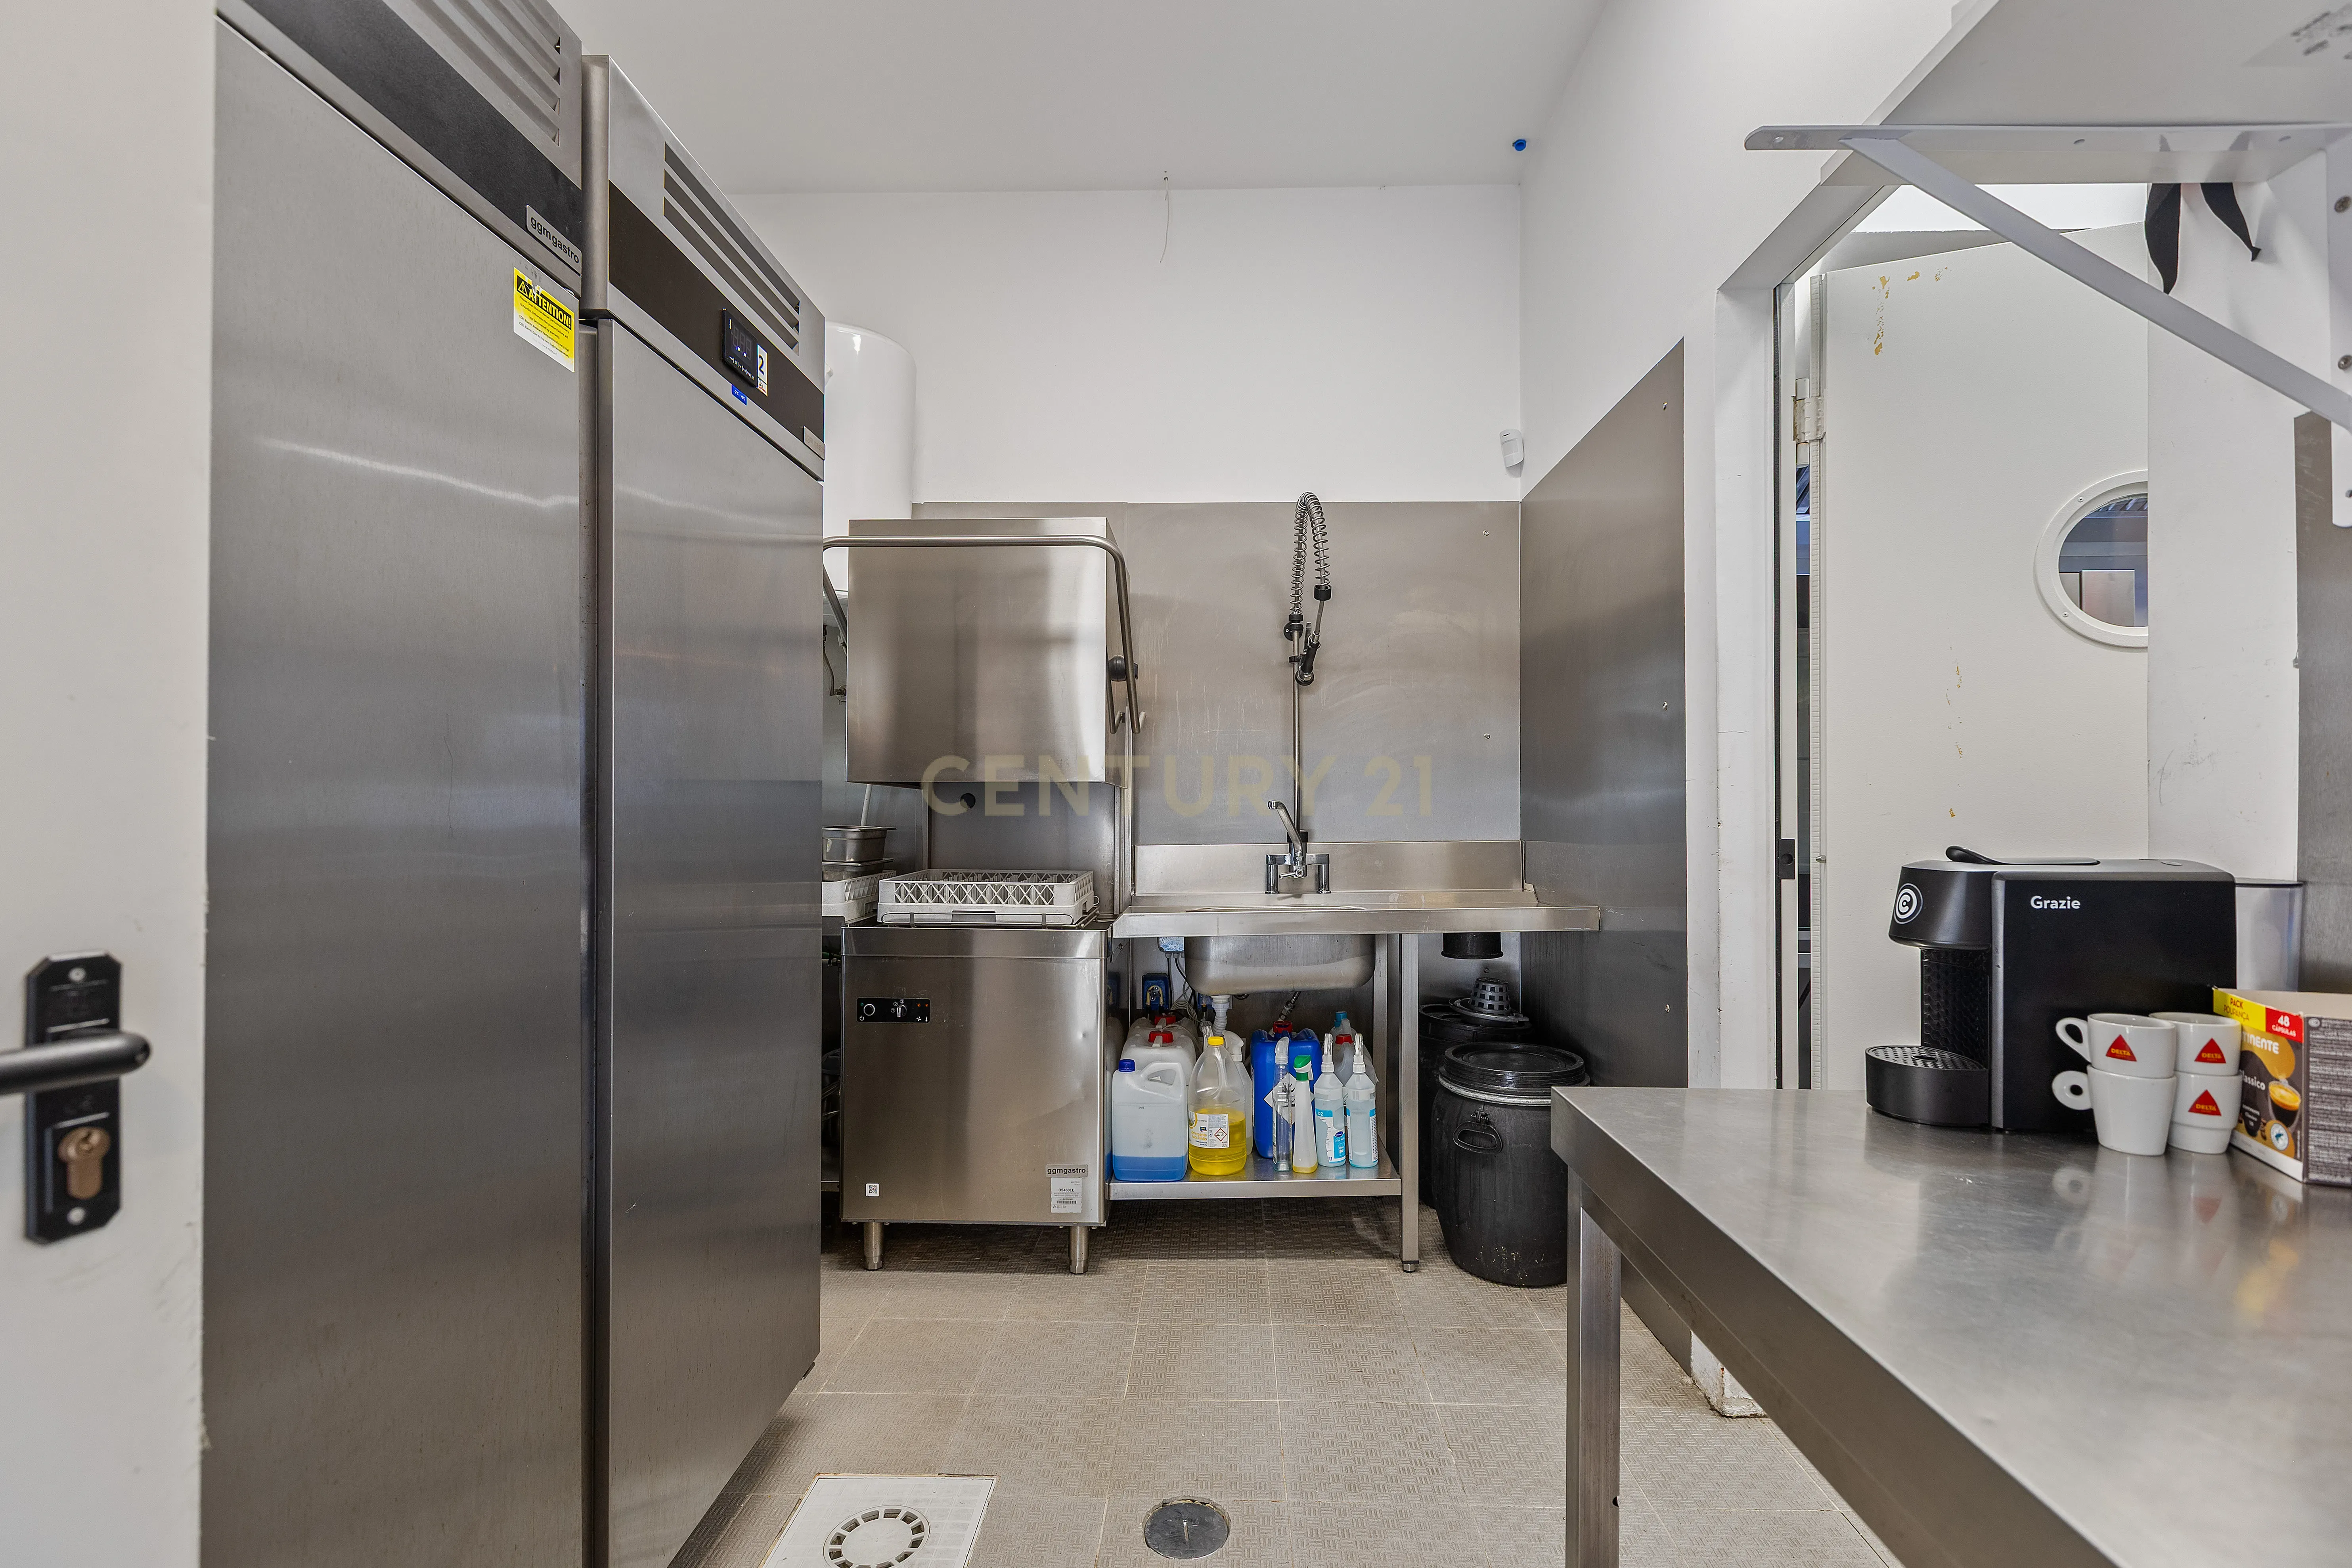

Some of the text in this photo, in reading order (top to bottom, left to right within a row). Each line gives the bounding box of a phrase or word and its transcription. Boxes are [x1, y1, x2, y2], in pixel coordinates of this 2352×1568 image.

[528, 289, 571, 328] ATTENTION!
[759, 354, 764, 375] 2
[2030, 896, 2081, 909] Grazie
[2230, 997, 2243, 1009] PACK
[2224, 1004, 2249, 1022] POUPANÇA
[2278, 1015, 2290, 1027] 48
[2272, 1024, 2296, 1037] CÁPSULAS
[2243, 1032, 2279, 1054] TINENTE
